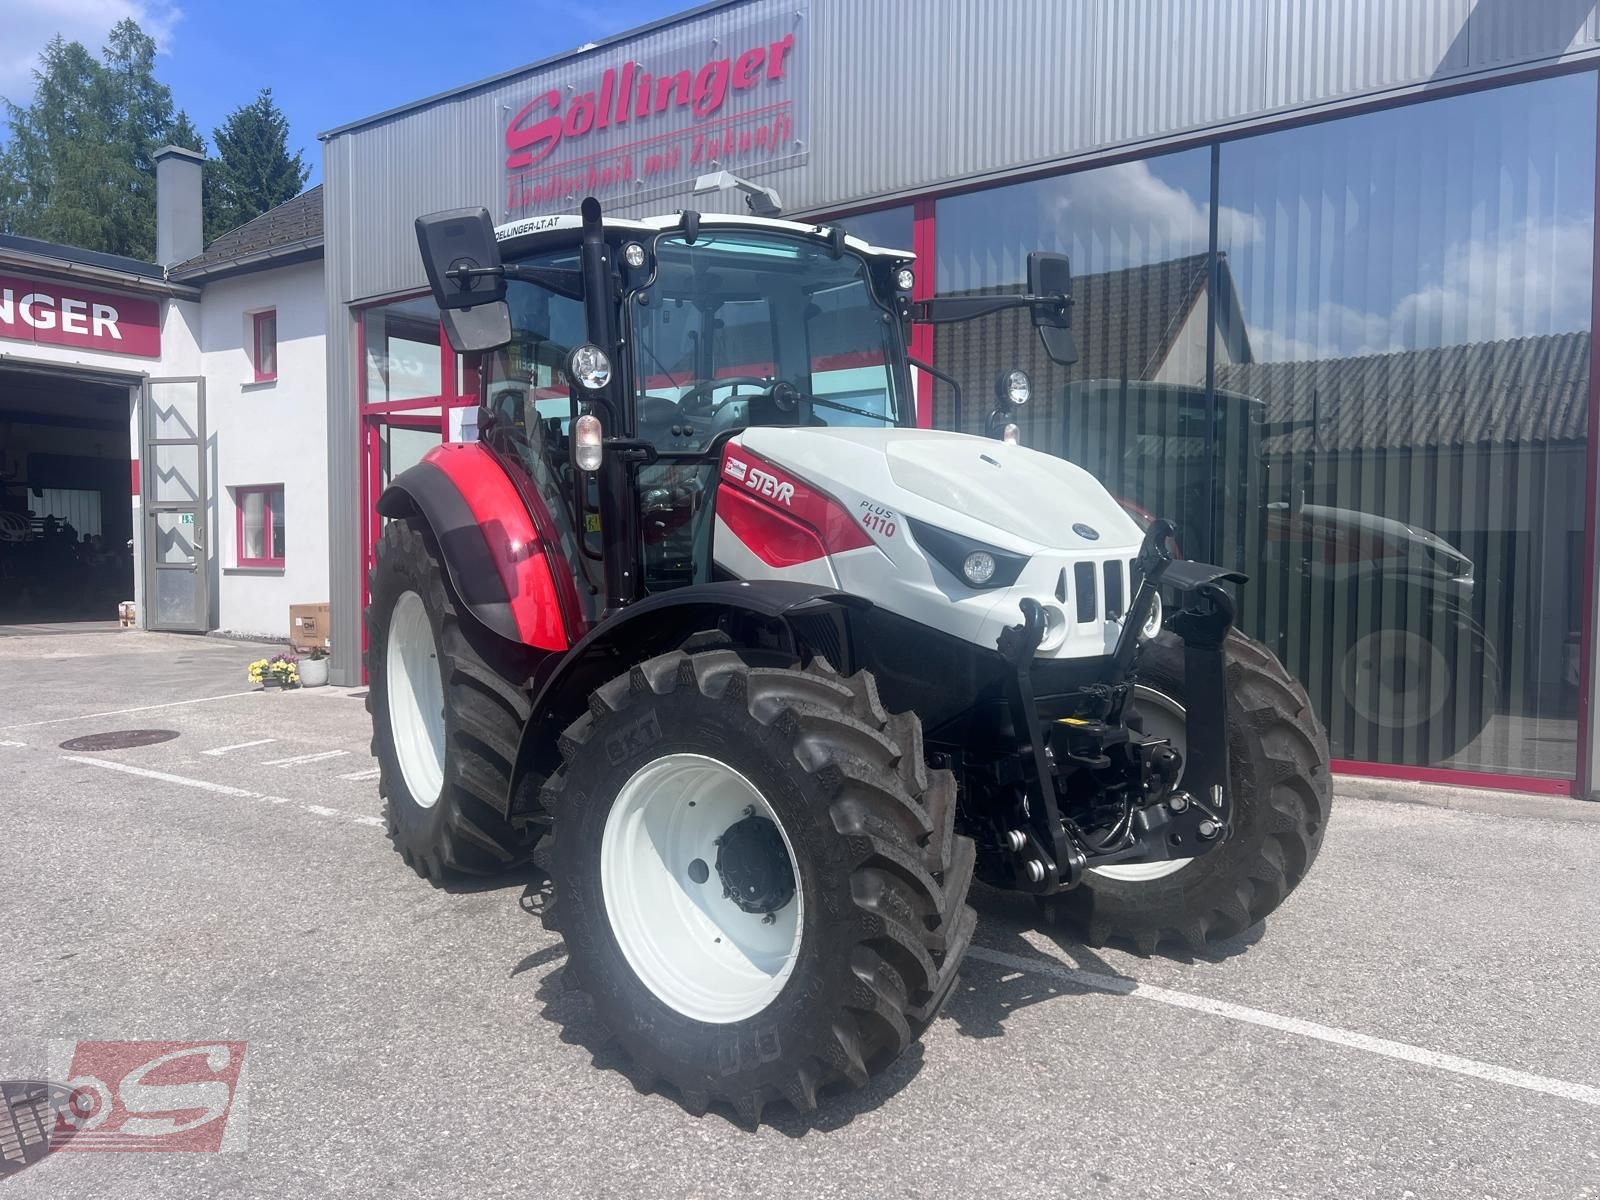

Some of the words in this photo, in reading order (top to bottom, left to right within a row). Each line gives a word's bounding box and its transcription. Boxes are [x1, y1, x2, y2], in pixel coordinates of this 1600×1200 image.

[505, 33, 795, 169] Söllinger
[507, 154, 633, 209] Landtechnik
[644, 144, 679, 176] mit
[689, 111, 791, 165] Zukunft
[745, 468, 795, 506] STEYR
[859, 500, 894, 519] PLUS
[862, 512, 896, 538] 4110
